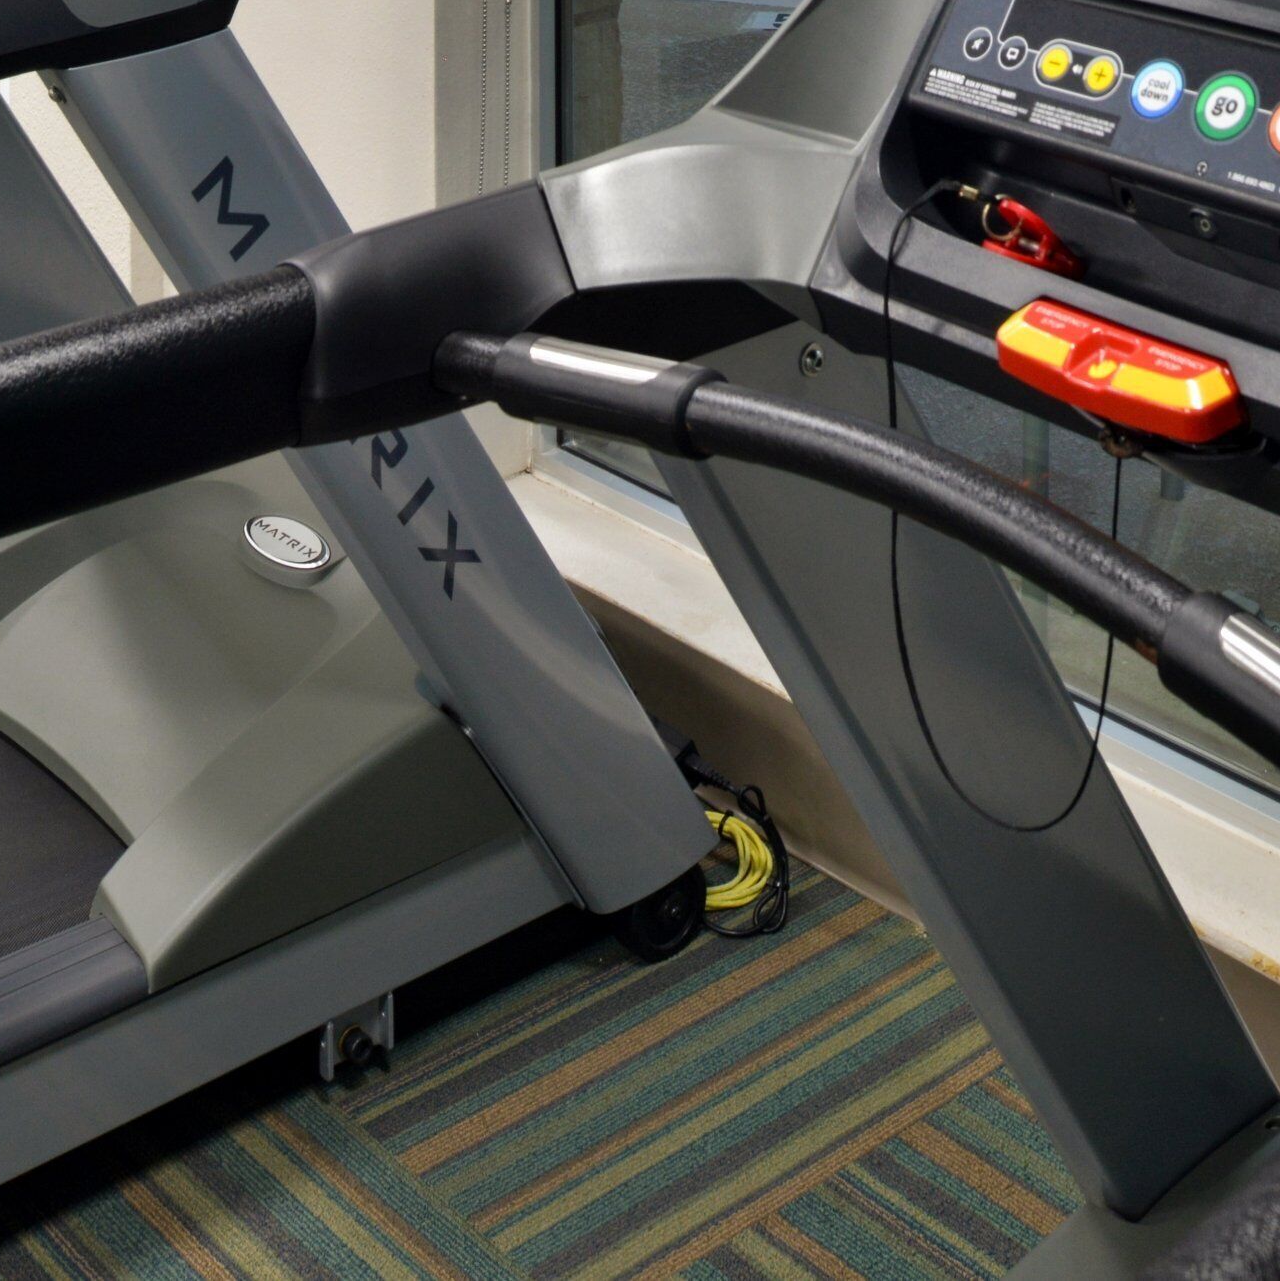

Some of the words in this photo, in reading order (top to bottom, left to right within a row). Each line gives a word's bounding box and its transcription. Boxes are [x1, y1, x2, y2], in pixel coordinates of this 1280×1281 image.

[1141, 87, 1169, 102] down
[1148, 78, 1171, 90] cool
[1211, 96, 1238, 116] go
[1036, 306, 1089, 328] EMERGENCY
[1148, 346, 1206, 370] EMERGENCY
[254, 519, 318, 558] MATRIX
